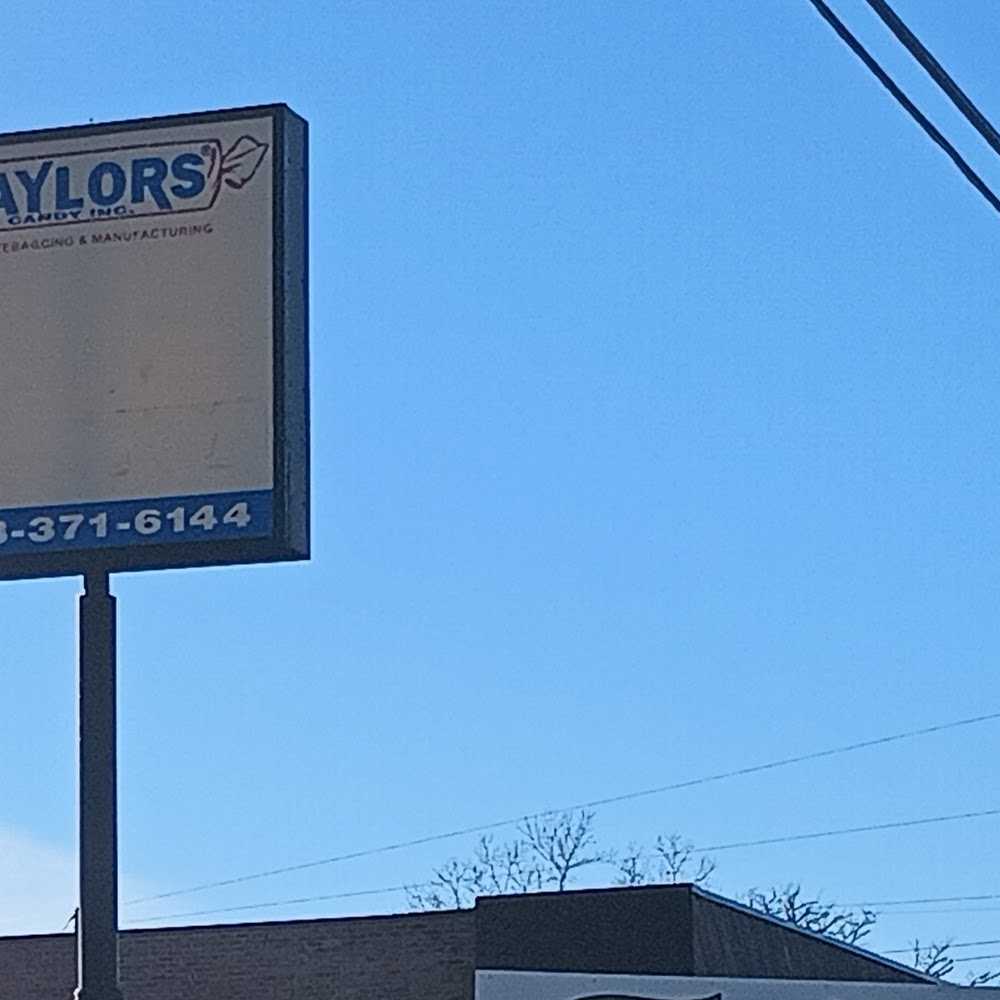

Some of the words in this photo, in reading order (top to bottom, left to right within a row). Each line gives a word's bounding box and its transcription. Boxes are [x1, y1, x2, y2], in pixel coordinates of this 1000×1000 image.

[8, 210, 81, 225] CANDY
[89, 205, 134, 217] INC.
[79, 236, 86, 245] &
[91, 223, 213, 244] MANUFACTURING
